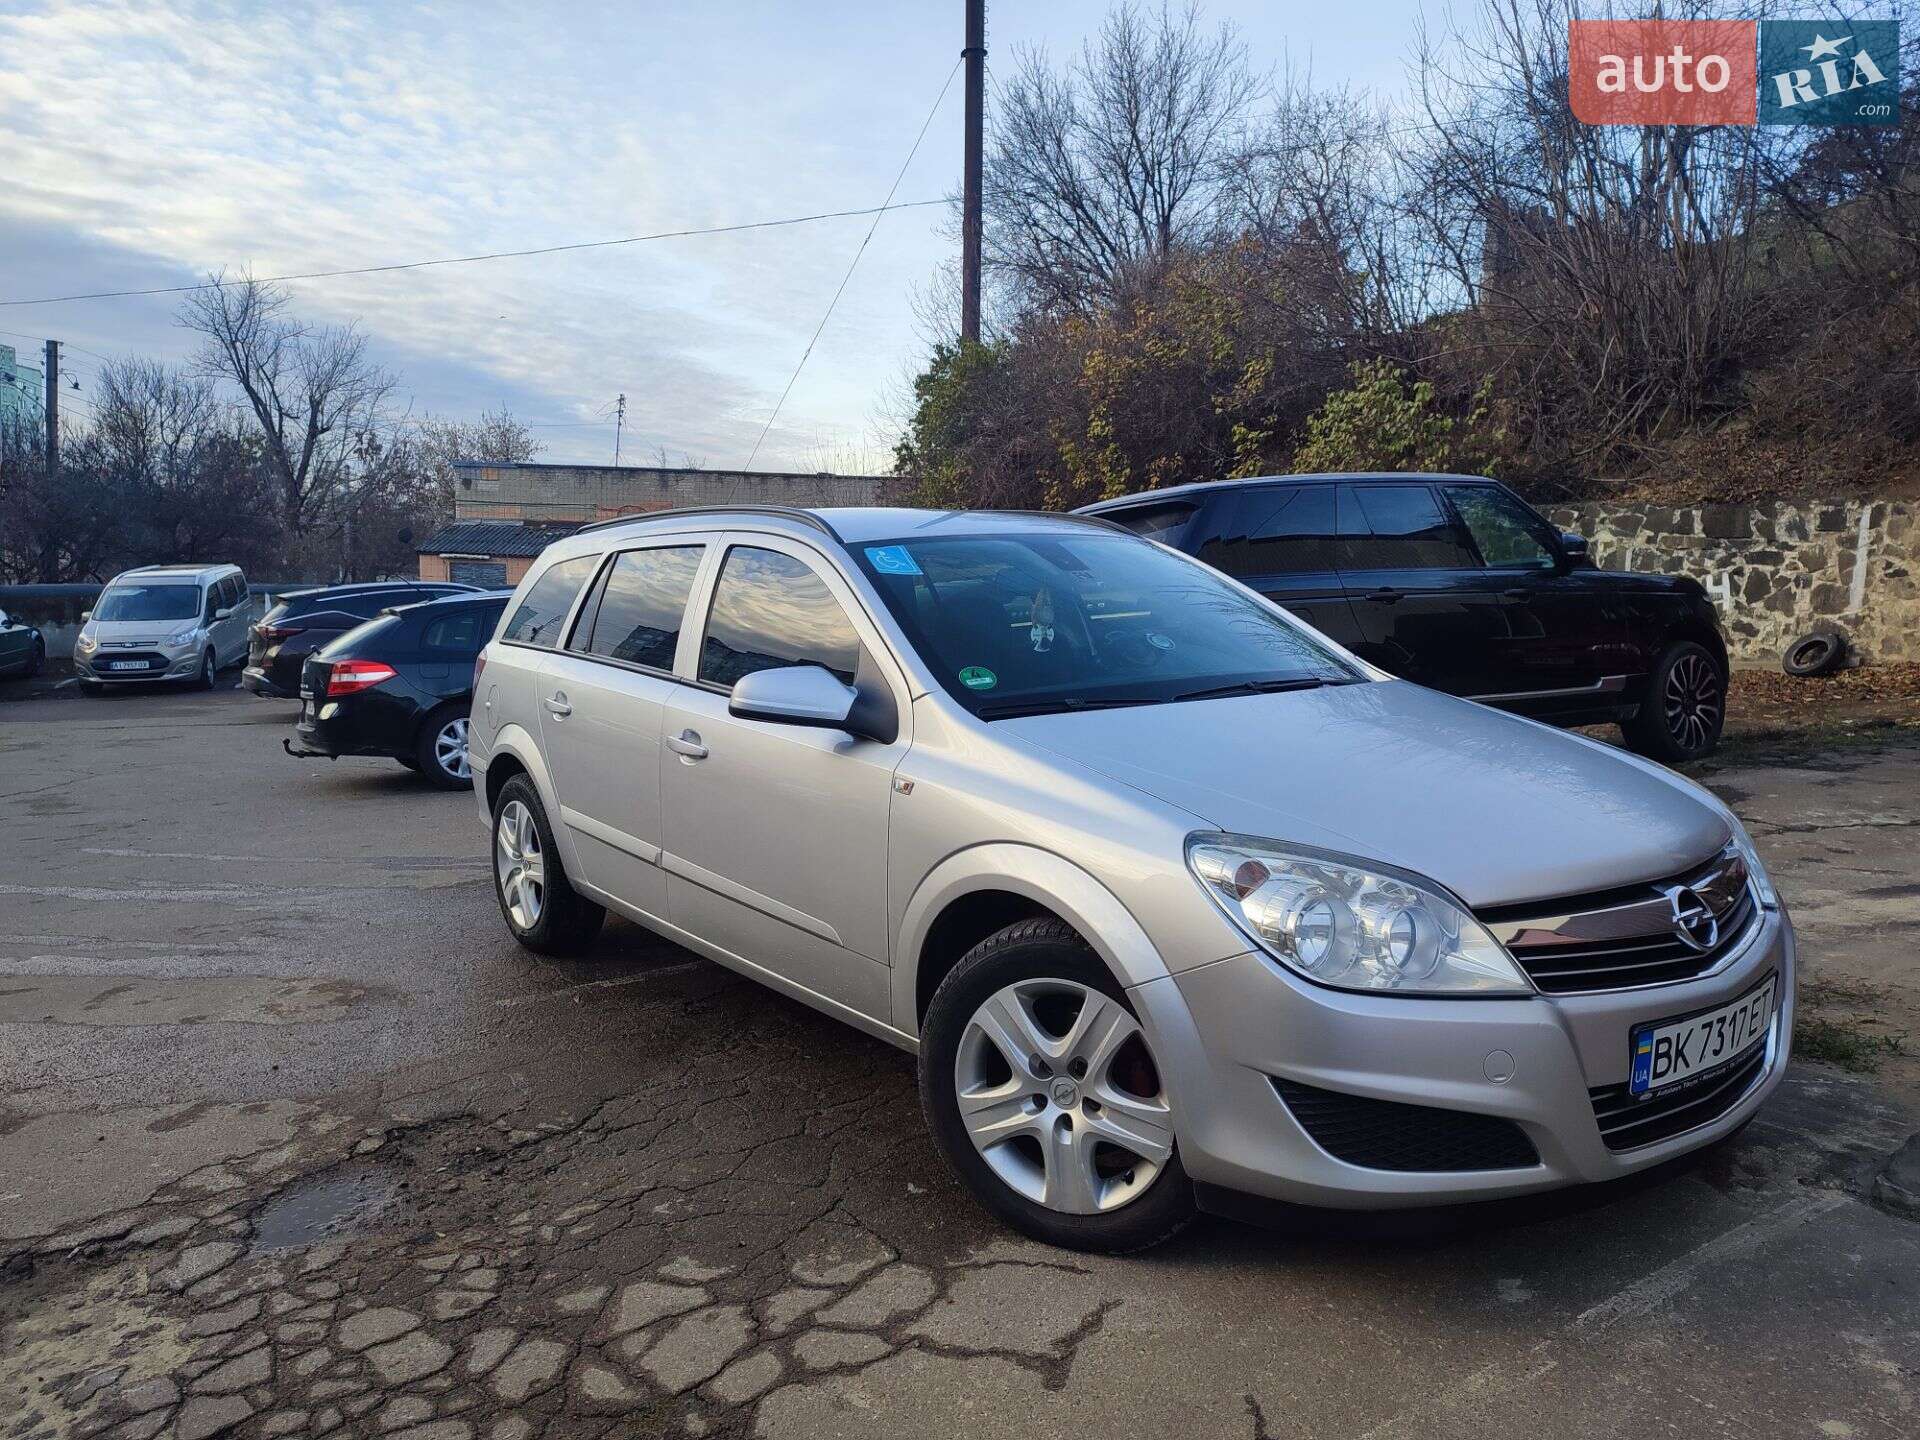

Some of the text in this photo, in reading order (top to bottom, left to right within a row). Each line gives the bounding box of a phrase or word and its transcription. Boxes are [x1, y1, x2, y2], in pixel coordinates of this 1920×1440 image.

[1653, 1028, 1694, 1080] BK
[1699, 1005, 1748, 1064] 7317
[1748, 989, 1771, 1036] ET
[1634, 1070, 1648, 1084] UA
